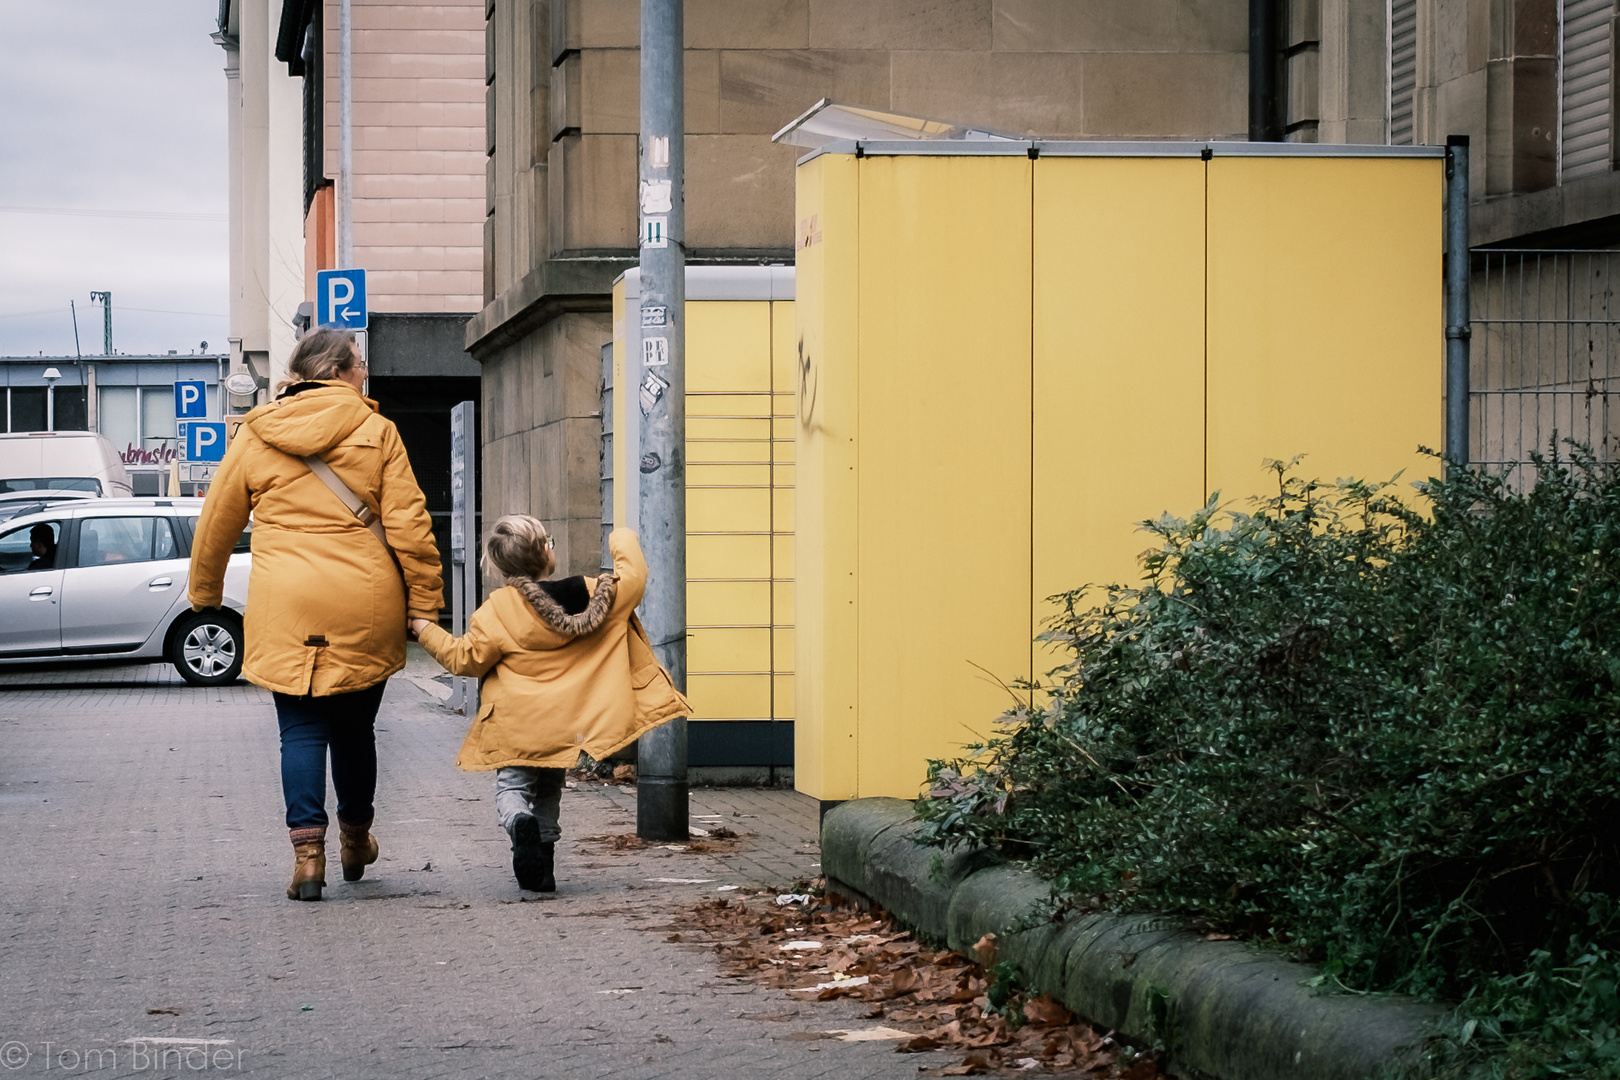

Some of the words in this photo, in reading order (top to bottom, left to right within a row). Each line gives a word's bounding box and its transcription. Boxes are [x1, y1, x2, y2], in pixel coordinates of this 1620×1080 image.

[328, 277, 355, 322] P
[181, 385, 199, 414] P
[195, 426, 218, 457] P
